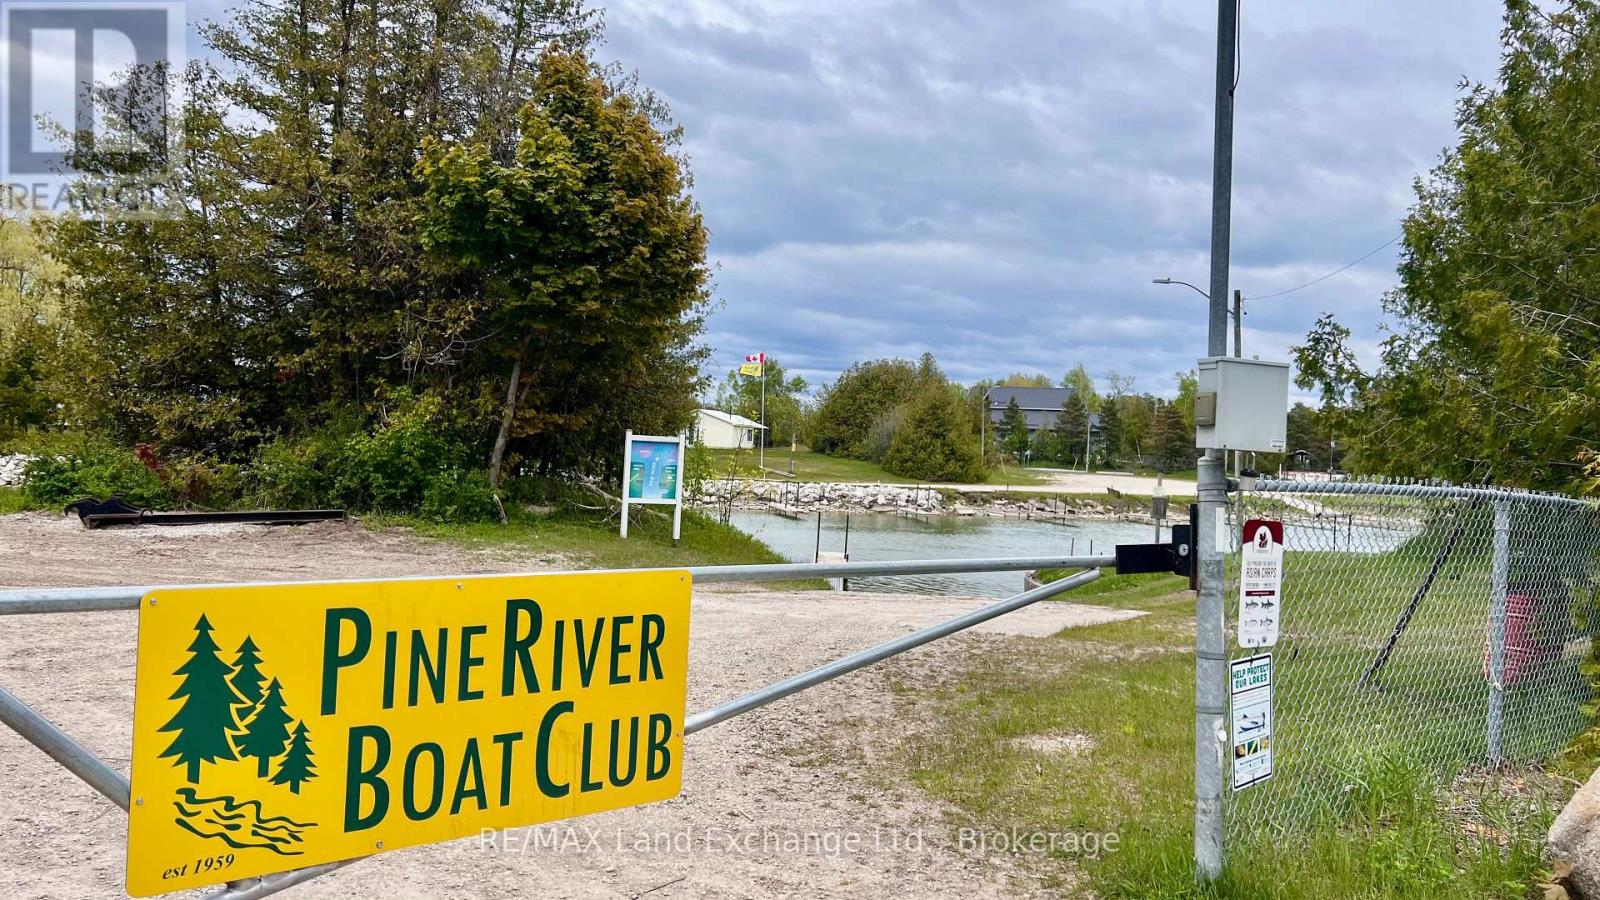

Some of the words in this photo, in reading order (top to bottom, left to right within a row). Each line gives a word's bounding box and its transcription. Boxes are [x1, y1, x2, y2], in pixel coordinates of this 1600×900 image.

[320, 606, 488, 716] PINE
[501, 598, 666, 697] RIVER
[1232, 668, 1246, 680] HELP
[1246, 663, 1270, 676] PROTECT
[1235, 678, 1247, 689] OUR
[1249, 672, 1268, 685] LAKES
[343, 724, 523, 834] BOAT
[534, 700, 673, 798] CLUB
[162, 863, 188, 880] est
[194, 853, 235, 874] 1959
